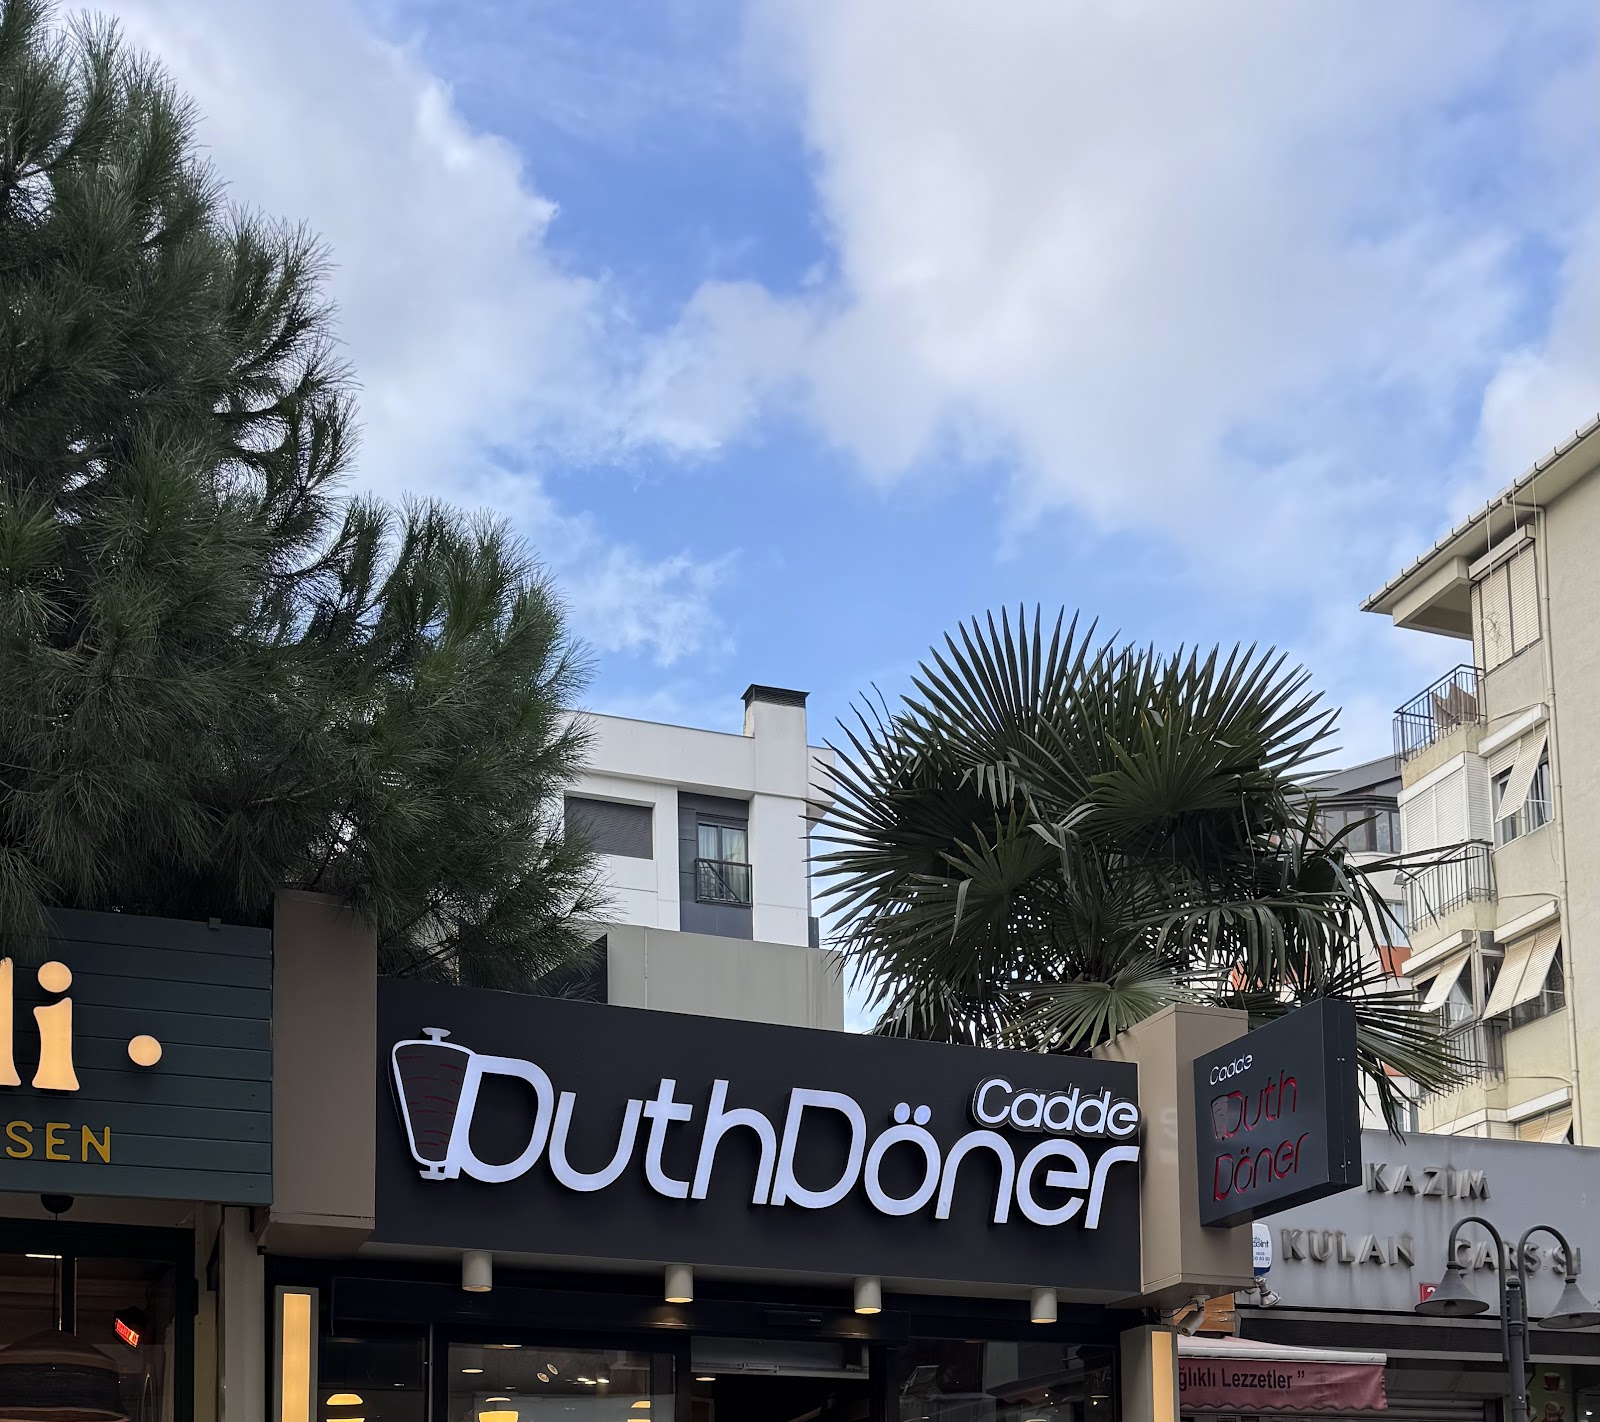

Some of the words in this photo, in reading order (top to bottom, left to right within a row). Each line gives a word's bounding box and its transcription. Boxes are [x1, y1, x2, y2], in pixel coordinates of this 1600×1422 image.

[1209, 1054, 1254, 1086] Cadde
[975, 1077, 1139, 1137] Cadde
[1211, 1070, 1299, 1140] Duth
[5, 1120, 111, 1164] SEN
[1213, 1132, 1310, 1203] Döner
[1365, 1162, 1491, 1200] KAZIM
[1281, 1228, 1415, 1267] KULAN
[1222, 1367, 1293, 1389] Lezzetler
